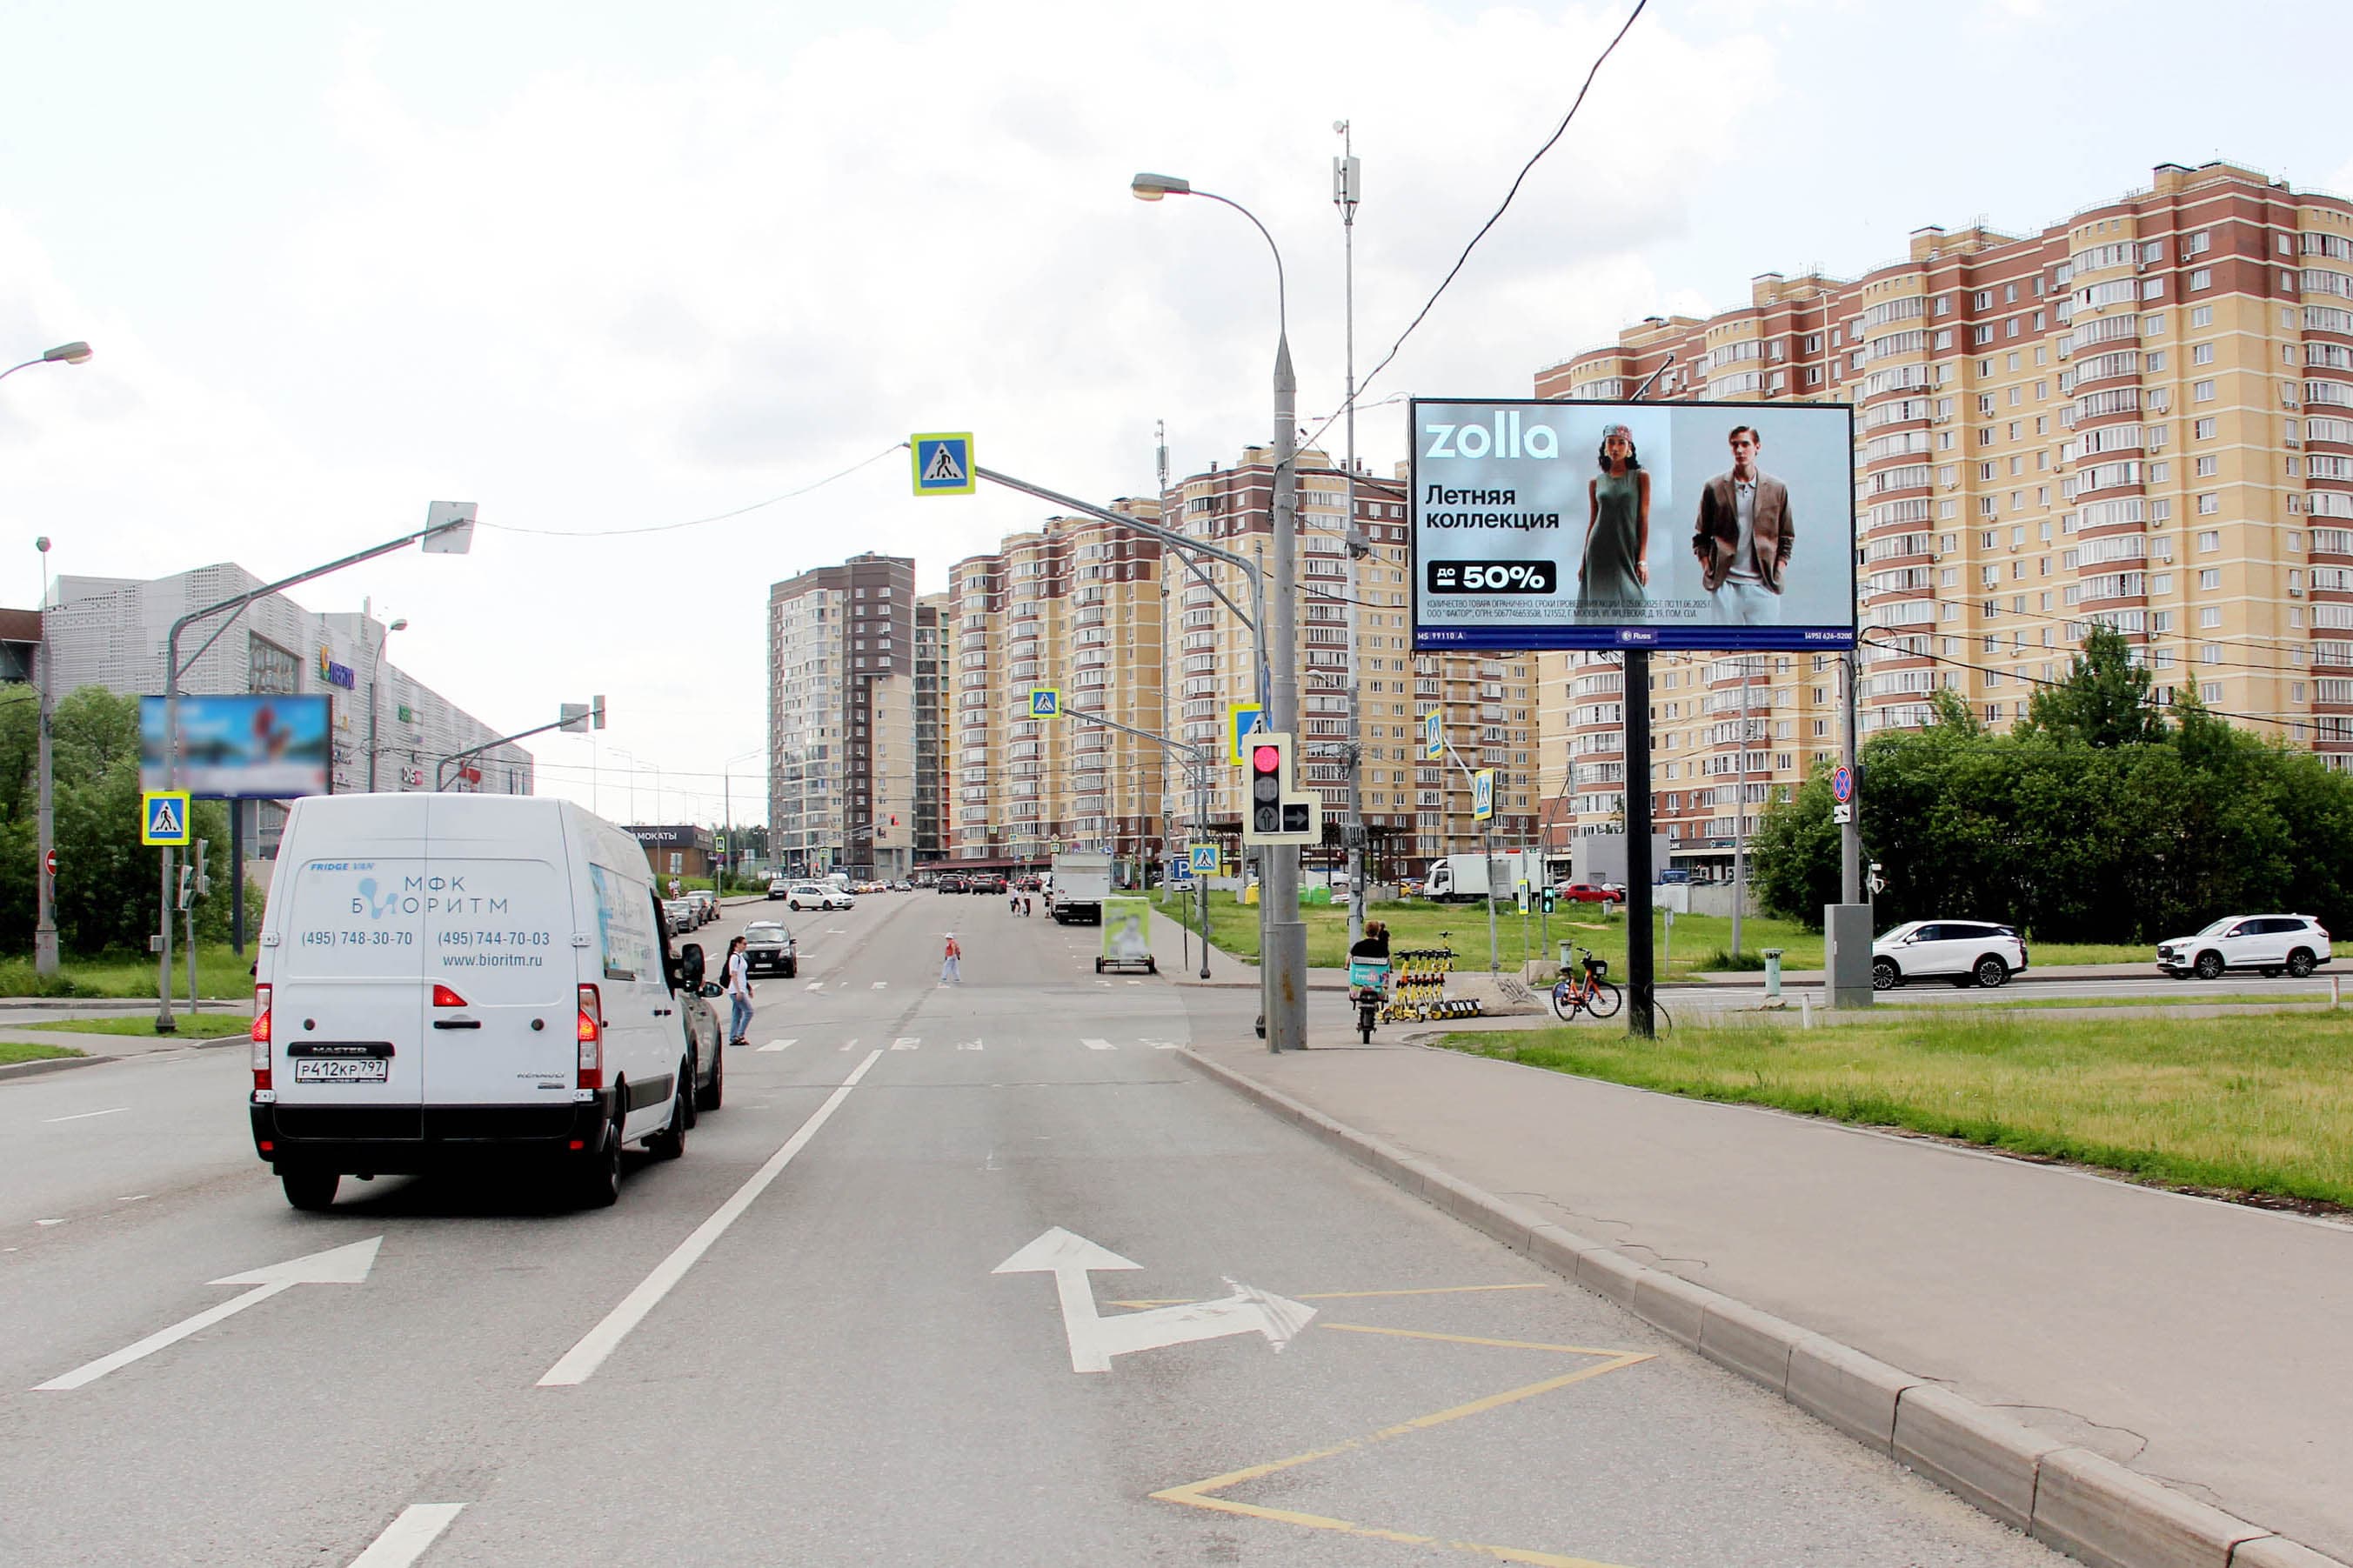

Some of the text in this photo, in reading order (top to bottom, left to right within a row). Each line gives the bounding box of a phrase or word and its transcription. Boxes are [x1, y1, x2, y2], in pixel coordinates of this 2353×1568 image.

[1426, 410, 1559, 459] zolla
[1426, 484, 1515, 504] Летняя
[1427, 513, 1559, 531] коллекция
[1437, 568, 1455, 577] до
[405, 877, 465, 891] МФК
[302, 931, 413, 947] (495) 748-30-70
[438, 931, 550, 947] (495) 744-70-03
[443, 953, 542, 966] www.bioritm.ru
